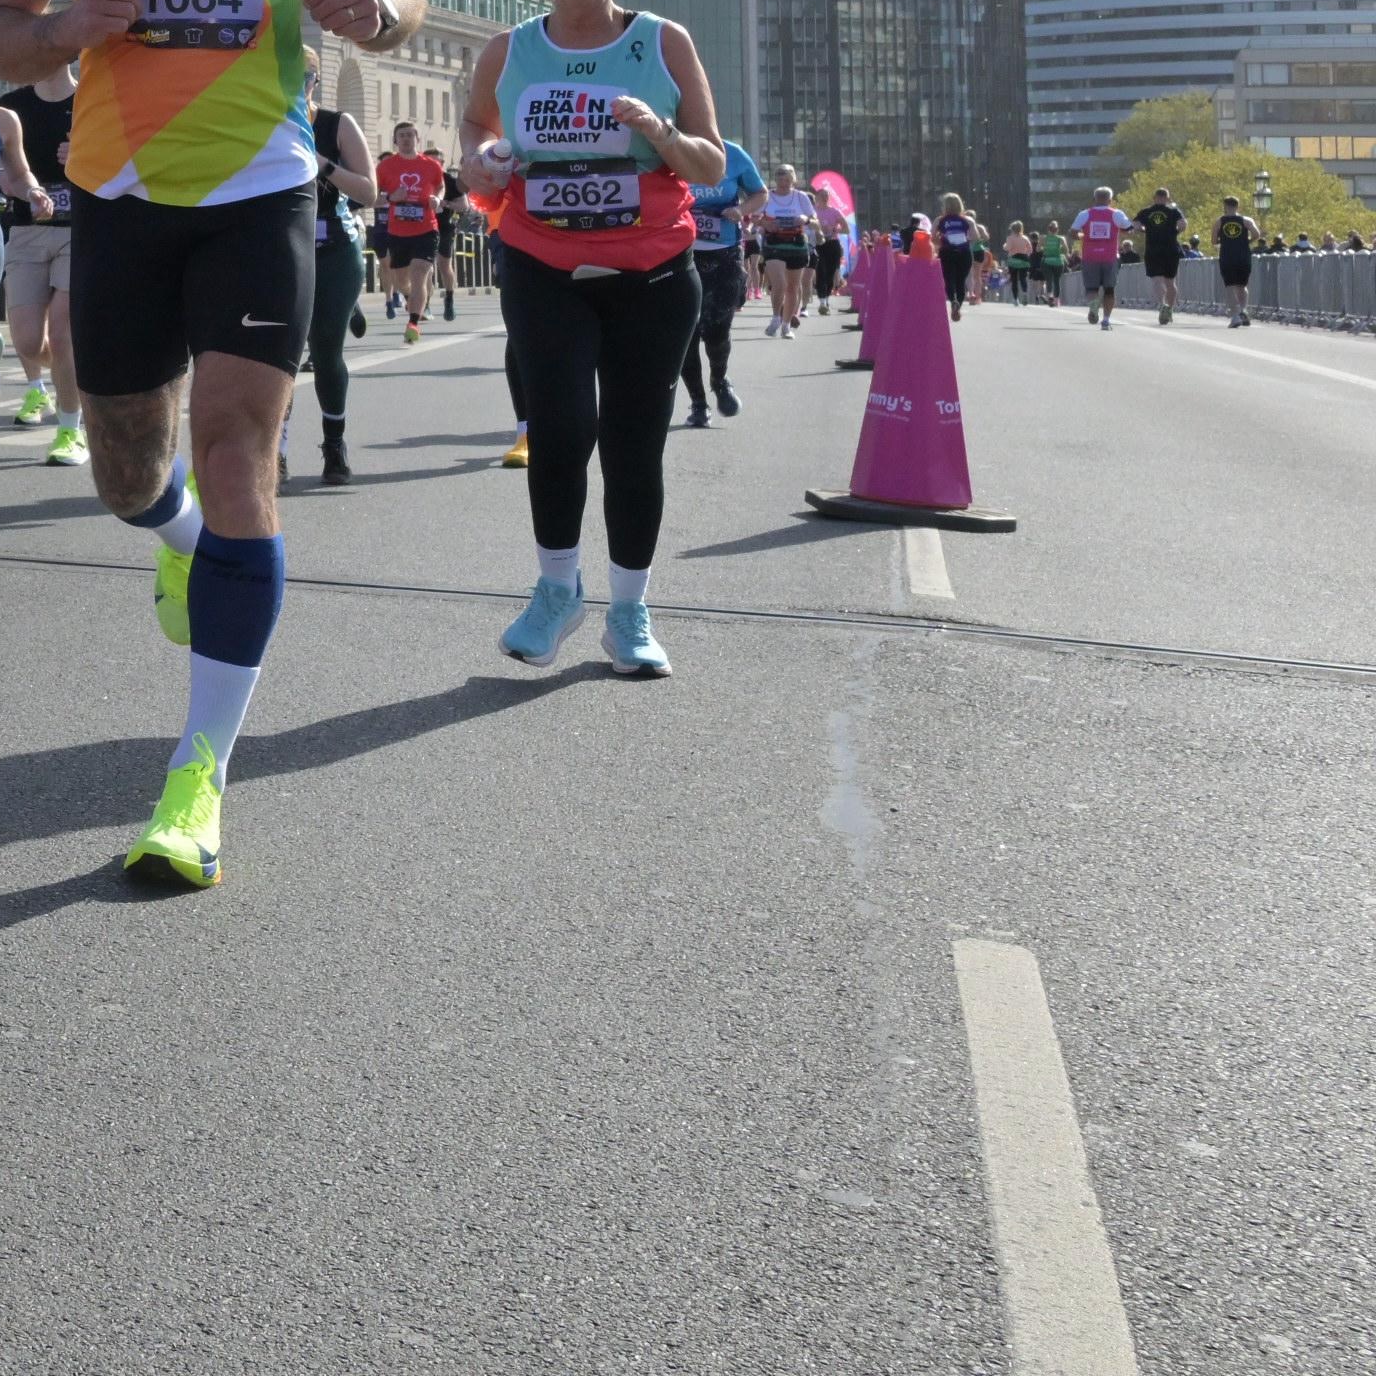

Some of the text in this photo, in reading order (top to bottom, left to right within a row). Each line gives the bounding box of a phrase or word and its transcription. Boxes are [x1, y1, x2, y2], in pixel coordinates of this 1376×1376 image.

[566, 62, 597, 77] LOU
[549, 90, 575, 99] THE
[535, 132, 601, 144] CHARITY
[569, 164, 588, 173] LOU
[542, 179, 623, 207] 2662
[869, 392, 913, 413] mmy's
